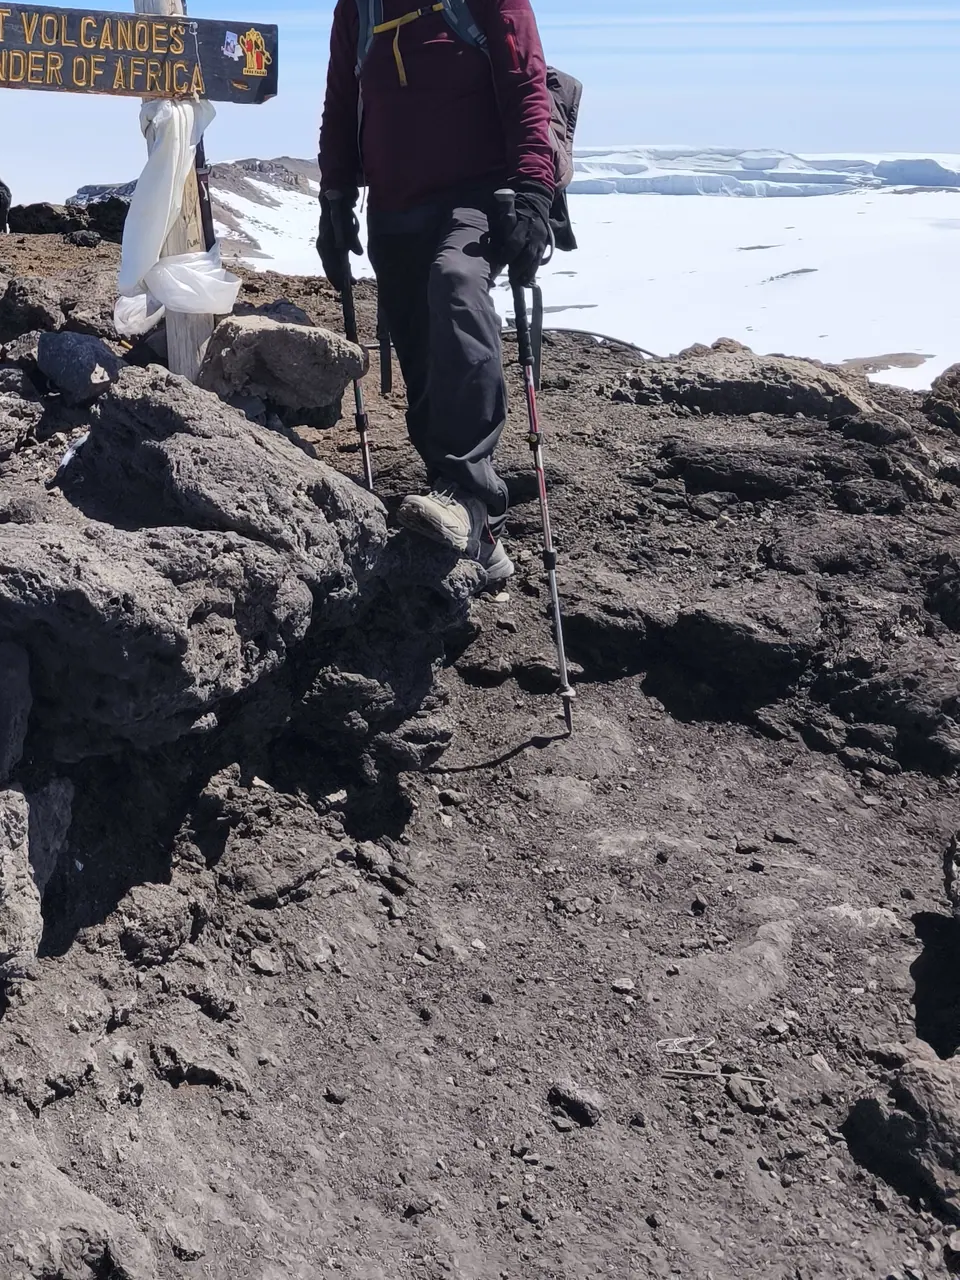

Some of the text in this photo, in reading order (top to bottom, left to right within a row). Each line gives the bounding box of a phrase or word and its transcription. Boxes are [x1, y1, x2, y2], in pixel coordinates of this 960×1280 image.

[21, 11, 186, 56] VOLCANOES
[72, 54, 107, 87] OF
[112, 56, 206, 95] AFRICA
